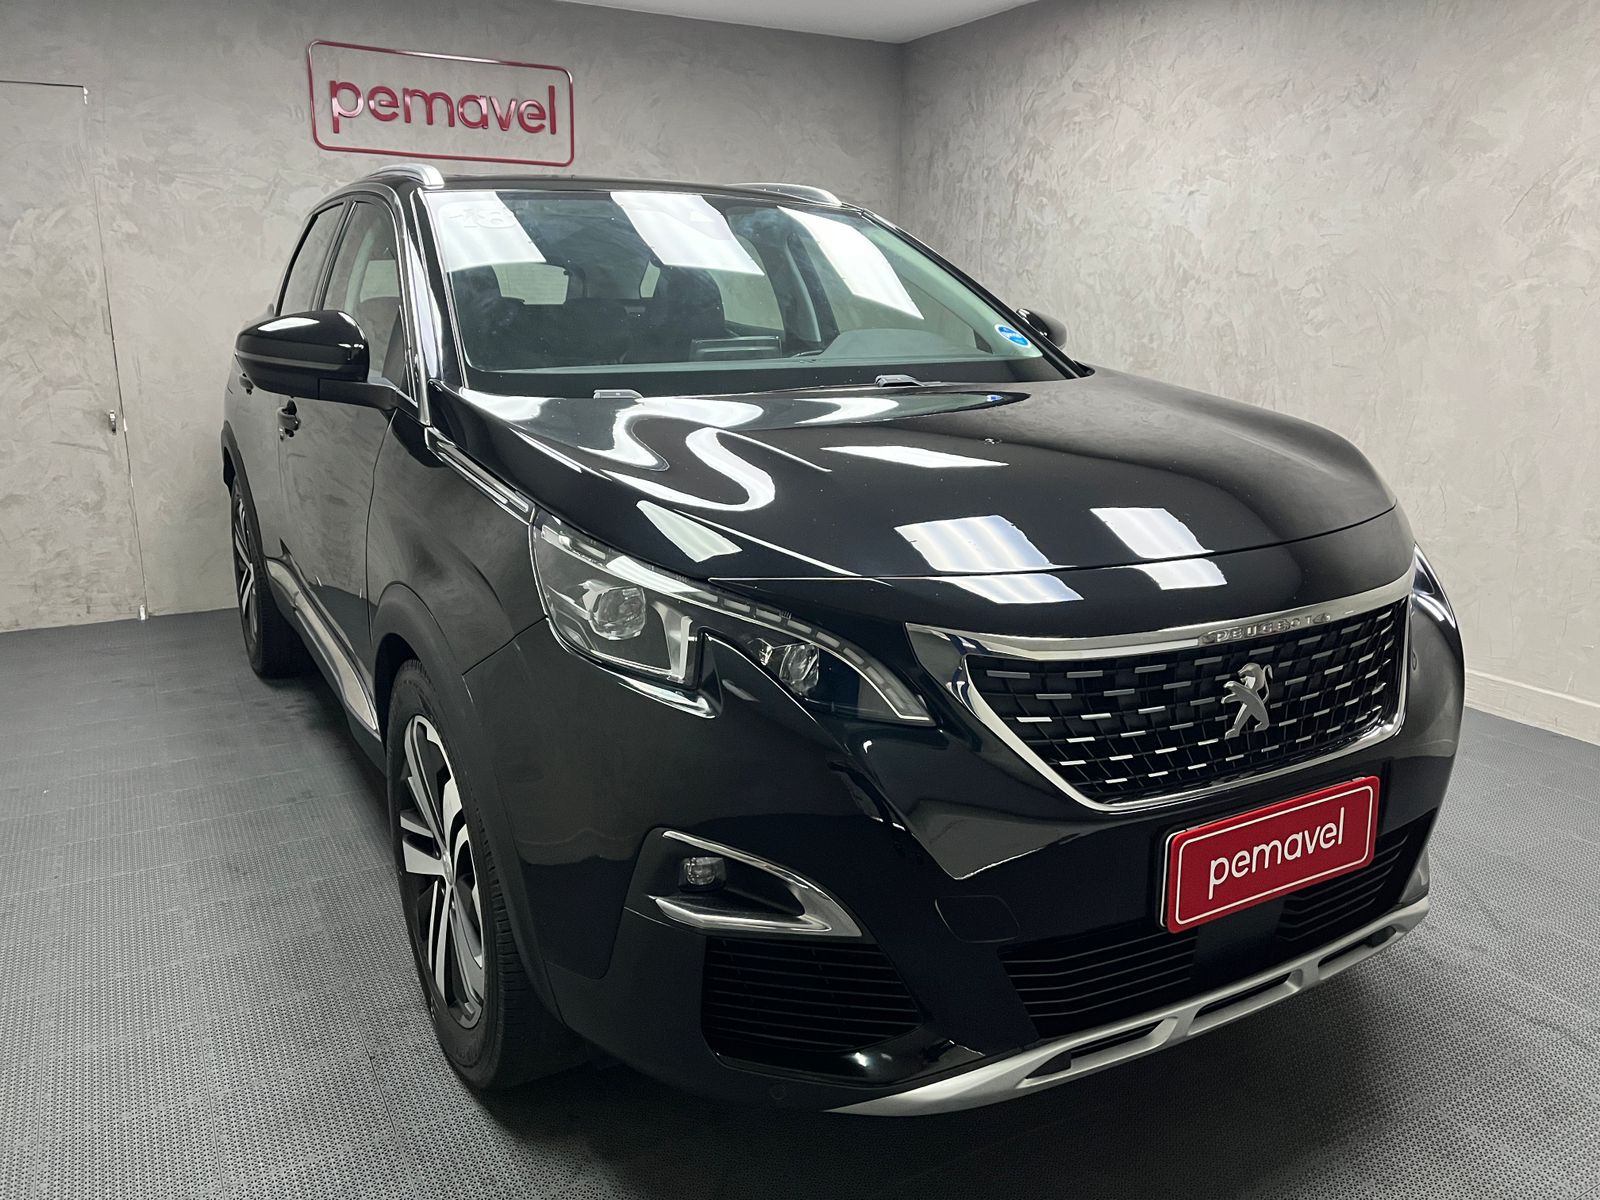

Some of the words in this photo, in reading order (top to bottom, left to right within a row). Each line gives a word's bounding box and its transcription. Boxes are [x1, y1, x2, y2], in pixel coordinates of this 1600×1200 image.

[329, 80, 557, 135] pemavel
[1216, 614, 1313, 643] PEUGEOT
[1208, 806, 1345, 900] pemavel
